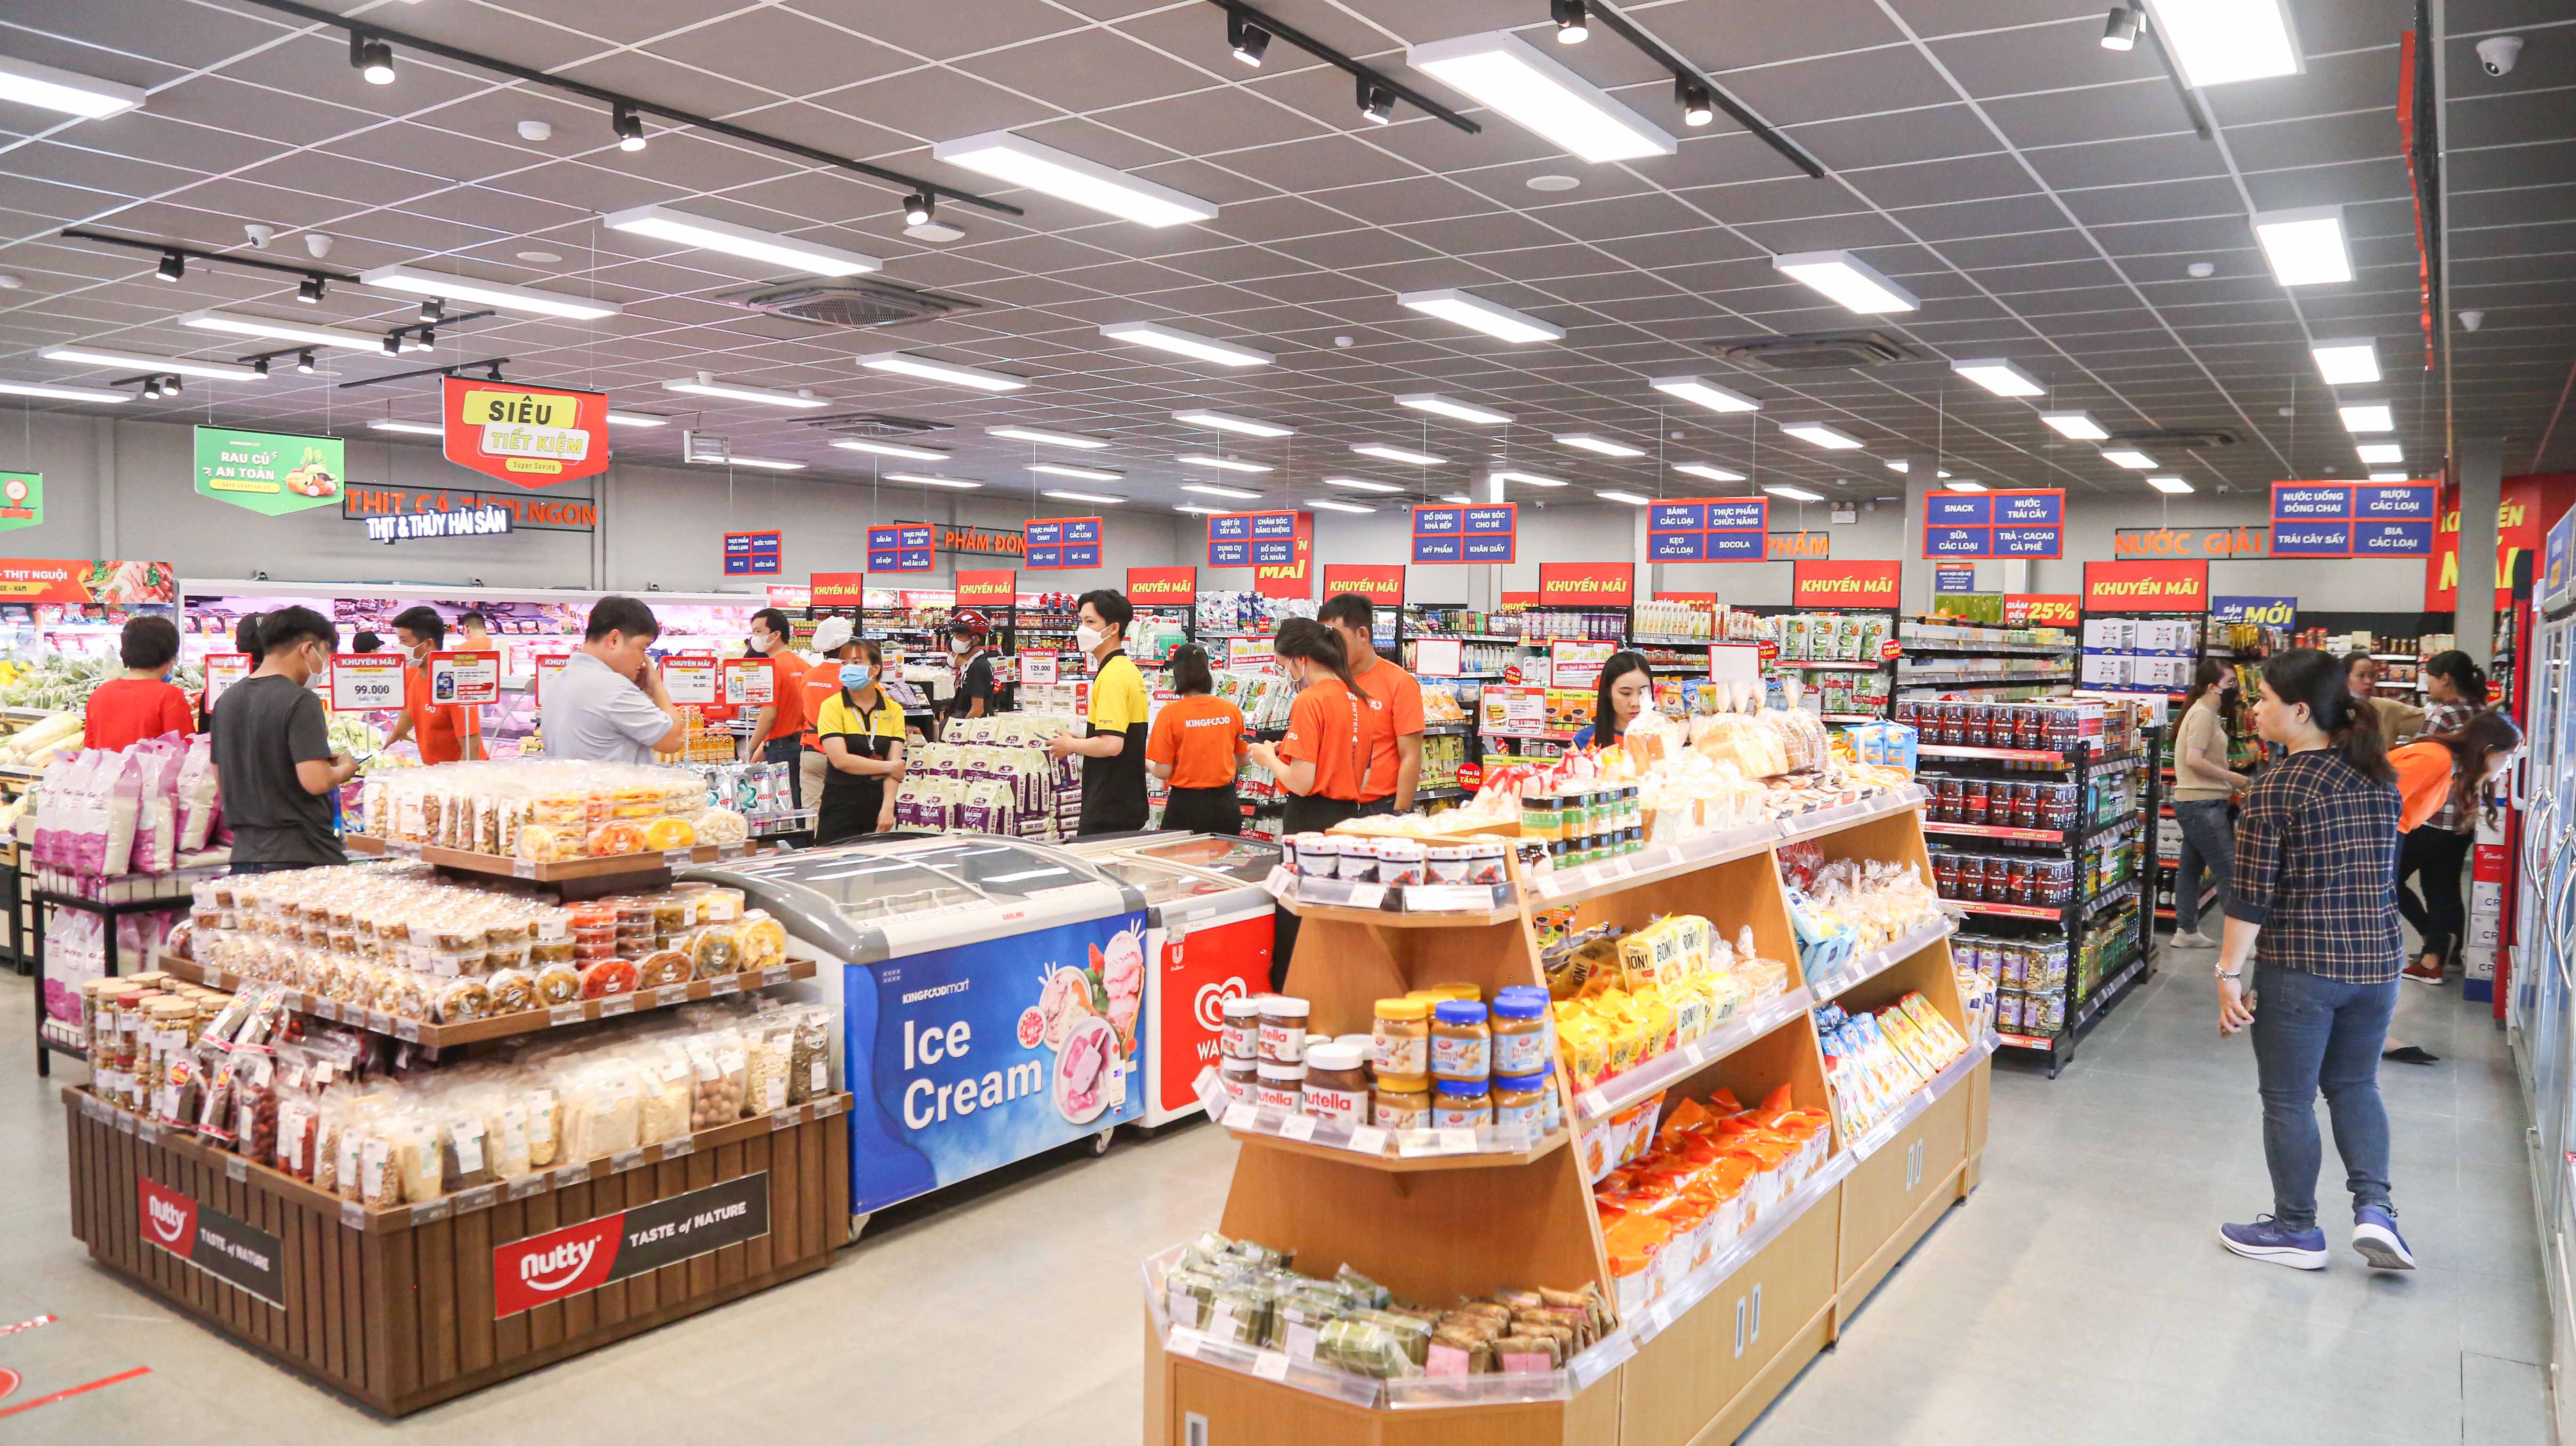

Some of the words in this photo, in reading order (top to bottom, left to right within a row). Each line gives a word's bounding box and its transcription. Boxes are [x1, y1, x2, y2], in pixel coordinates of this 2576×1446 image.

[489, 395, 552, 425] SIÊU
[491, 427, 532, 450] TIẾT
[536, 432, 583, 457] KIỆM
[221, 452, 248, 463] RAU
[252, 452, 270, 465] CỦ
[513, 461, 531, 469] Super
[534, 463, 555, 471] Saving
[216, 466, 234, 477] AN
[239, 466, 275, 480] TOÀN
[2283, 490, 2313, 501] NƯỚC
[2314, 489, 2344, 501] UỐNG
[2380, 489, 2411, 500] RƯỢU
[2015, 498, 2041, 508] NƯỚC
[2285, 503, 2314, 513] ĐÓNG
[2316, 504, 2341, 513] CHAI
[2370, 500, 2393, 510] CÁC
[2395, 502, 2420, 513] LOẠI
[528, 502, 597, 526] NGON
[1666, 506, 1688, 515] BÁNH
[1714, 508, 1734, 517] THỰC
[1735, 505, 1758, 515] PHẨM
[1945, 505, 1974, 513] SNACK
[2007, 510, 2027, 519] TRÁI
[2029, 508, 2047, 518] CÂY
[1258, 517, 1275, 525] CHĂM
[1424, 512, 1433, 520] ĐỒ
[1435, 512, 1453, 520] DÙNG
[1660, 516, 1675, 525] CÁC
[1677, 517, 1694, 526] LOẠI
[1714, 516, 1735, 525] CHỨC
[1736, 515, 1758, 525] NĂNG
[367, 517, 396, 543] THỊT
[398, 516, 409, 538] &
[409, 509, 446, 537] THỦY
[448, 507, 474, 535] HẢI
[475, 506, 506, 535] SẢN
[1440, 521, 1452, 529] BẾP
[1491, 520, 1500, 528] BÉ
[1272, 526, 1290, 534] MIỆNG
[1950, 530, 1968, 539] SỮA
[2000, 531, 2017, 540] TRÀ
[2384, 527, 2403, 536] BIA
[945, 525, 989, 551] PHẨM
[1669, 537, 1684, 546] KẸO
[2114, 527, 2191, 554] NƯỚC
[2203, 525, 2260, 554] GIẢI
[2278, 533, 2301, 544] TRÁI
[2303, 533, 2323, 544] CÂY
[2325, 532, 2346, 544] SẤY
[2369, 537, 2391, 547] CÁC
[2393, 538, 2418, 549] LOẠI
[1423, 545, 1433, 553] MỸ
[1434, 544, 1453, 553] PHẨM
[1470, 544, 1489, 553] KHĂN
[1489, 543, 1505, 552] GIẤY
[1660, 545, 1675, 554] CÁC
[1677, 546, 1693, 556] LOẠI
[1939, 542, 1956, 550] CÁC
[1958, 543, 1978, 552] LOẠI
[2011, 541, 2024, 551] CÀ
[2025, 541, 2043, 551] PHÊ
[1271, 553, 1286, 561] NHÂN
[4, 570, 30, 581] THỊT
[32, 569, 68, 581] NGUỘI
[814, 584, 843, 594] KHUYẾN
[844, 584, 858, 594] MÃI
[960, 582, 993, 594] KHUYẾN
[995, 582, 1011, 594] MÃI
[1132, 578, 1170, 593] KHUYẾN
[1172, 579, 1191, 592] MÃI
[1330, 578, 1374, 592] KHUYẾN
[1377, 579, 1399, 593] MÃI
[1546, 577, 1599, 592] KHUYẾN
[1602, 578, 1626, 592] MÃI
[1801, 575, 1860, 592] KHUYẾN
[1863, 576, 1893, 592] MÃI
[2092, 577, 2162, 595] KHUYẾN
[2165, 578, 2199, 595] MÃI
[2006, 600, 2028, 609] GIẢM
[2029, 602, 2075, 620] 25%
[2223, 604, 2242, 613] SẢN
[2244, 601, 2294, 624] MỚI
[1884, 648, 1900, 656] TẶNG
[1506, 674, 1520, 682] TẶNG
[355, 685, 389, 694] 99.000
[1185, 716, 1230, 728] KINGFOOD
[1459, 776, 1480, 786] TẶNG
[1626, 954, 1650, 970] BON!
[904, 1020, 971, 1071] Ice
[903, 1060, 1042, 1130] Cream
[149, 1195, 187, 1242] nutty
[629, 1223, 675, 1248] TASTE
[679, 1218, 690, 1235] of
[694, 1202, 747, 1229] NATURE
[521, 1238, 596, 1291] nutty
